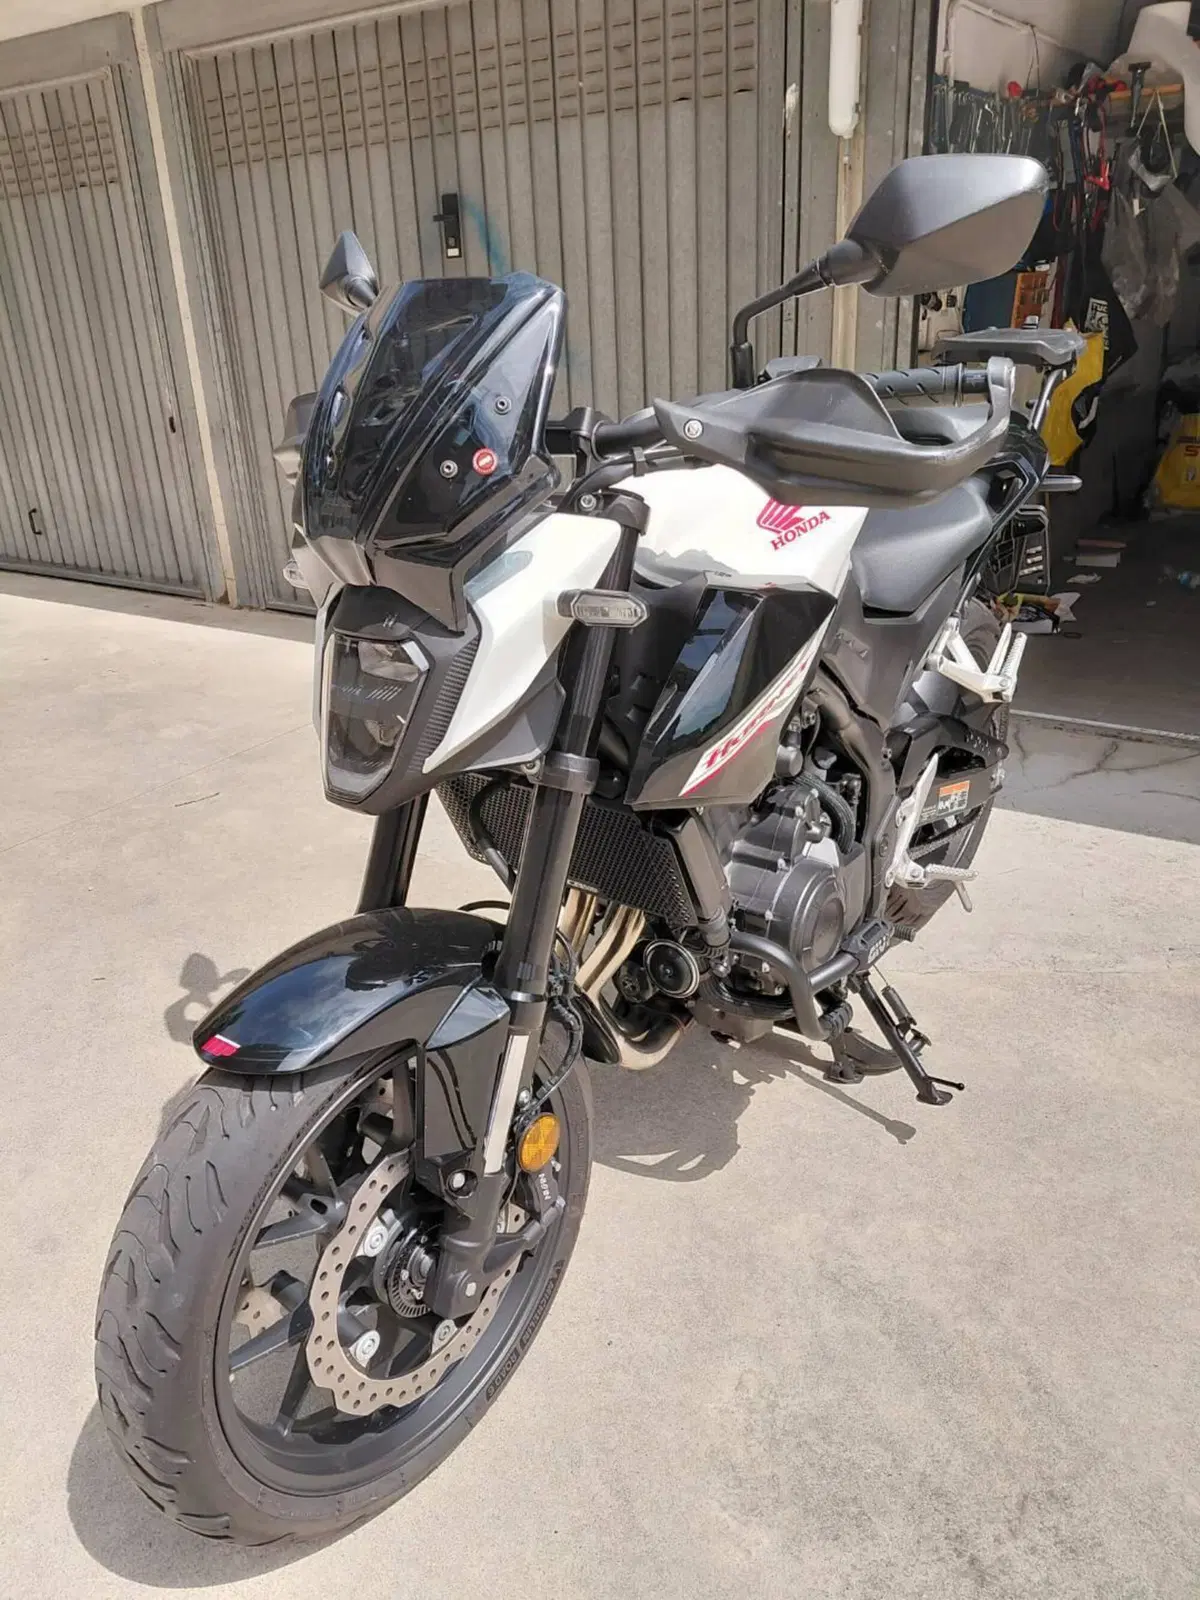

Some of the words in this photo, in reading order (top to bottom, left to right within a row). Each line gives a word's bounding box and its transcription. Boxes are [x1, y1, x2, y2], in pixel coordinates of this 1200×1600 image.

[770, 511, 830, 550] HONDA
[521, 1279, 555, 1343] MICHELIN
[492, 1351, 518, 1385] ROAD
